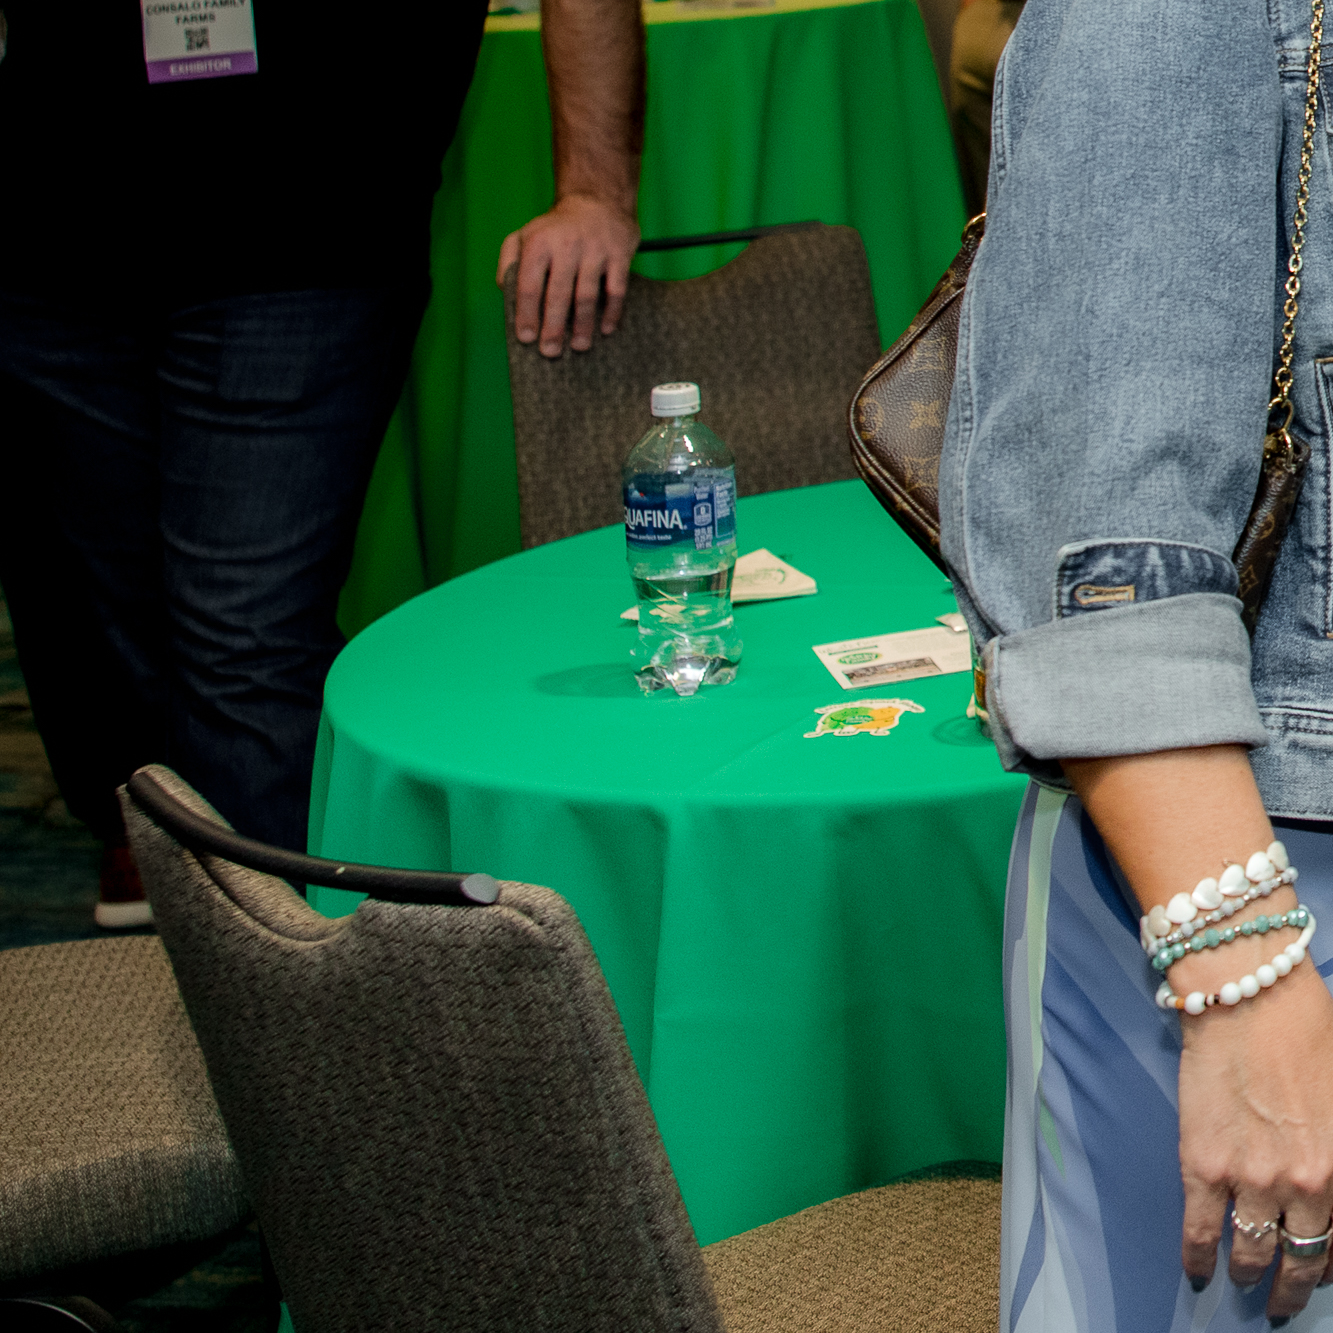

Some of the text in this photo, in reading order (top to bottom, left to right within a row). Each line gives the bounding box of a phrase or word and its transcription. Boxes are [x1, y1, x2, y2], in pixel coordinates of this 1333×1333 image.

[146, 0, 201, 16] CONSALO
[175, 13, 216, 25] FARMS
[169, 58, 232, 76] EXHIBITOR
